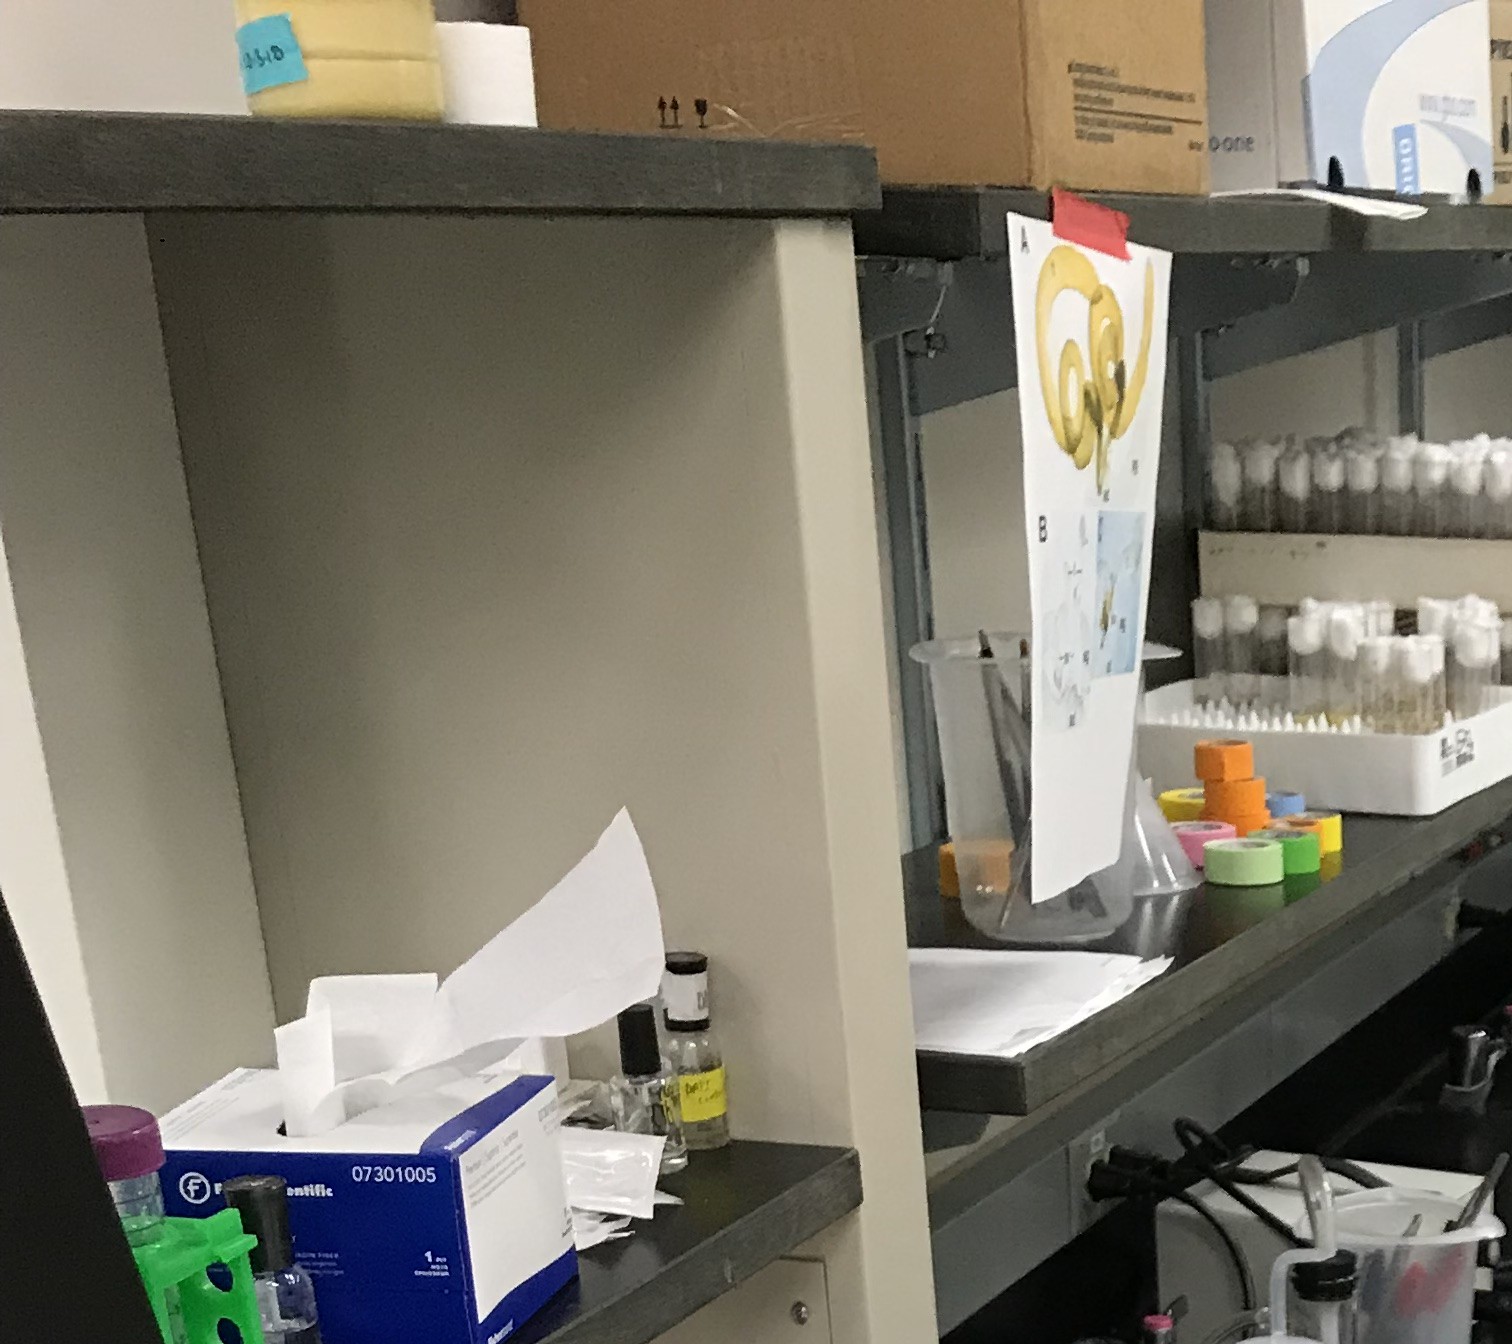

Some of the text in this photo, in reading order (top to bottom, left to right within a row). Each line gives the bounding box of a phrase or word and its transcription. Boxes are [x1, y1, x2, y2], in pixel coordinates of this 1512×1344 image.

[1021, 225, 1031, 254] A
[1038, 515, 1048, 543] B
[351, 1165, 437, 1183] 07301005
[286, 1184, 334, 1197] entific
